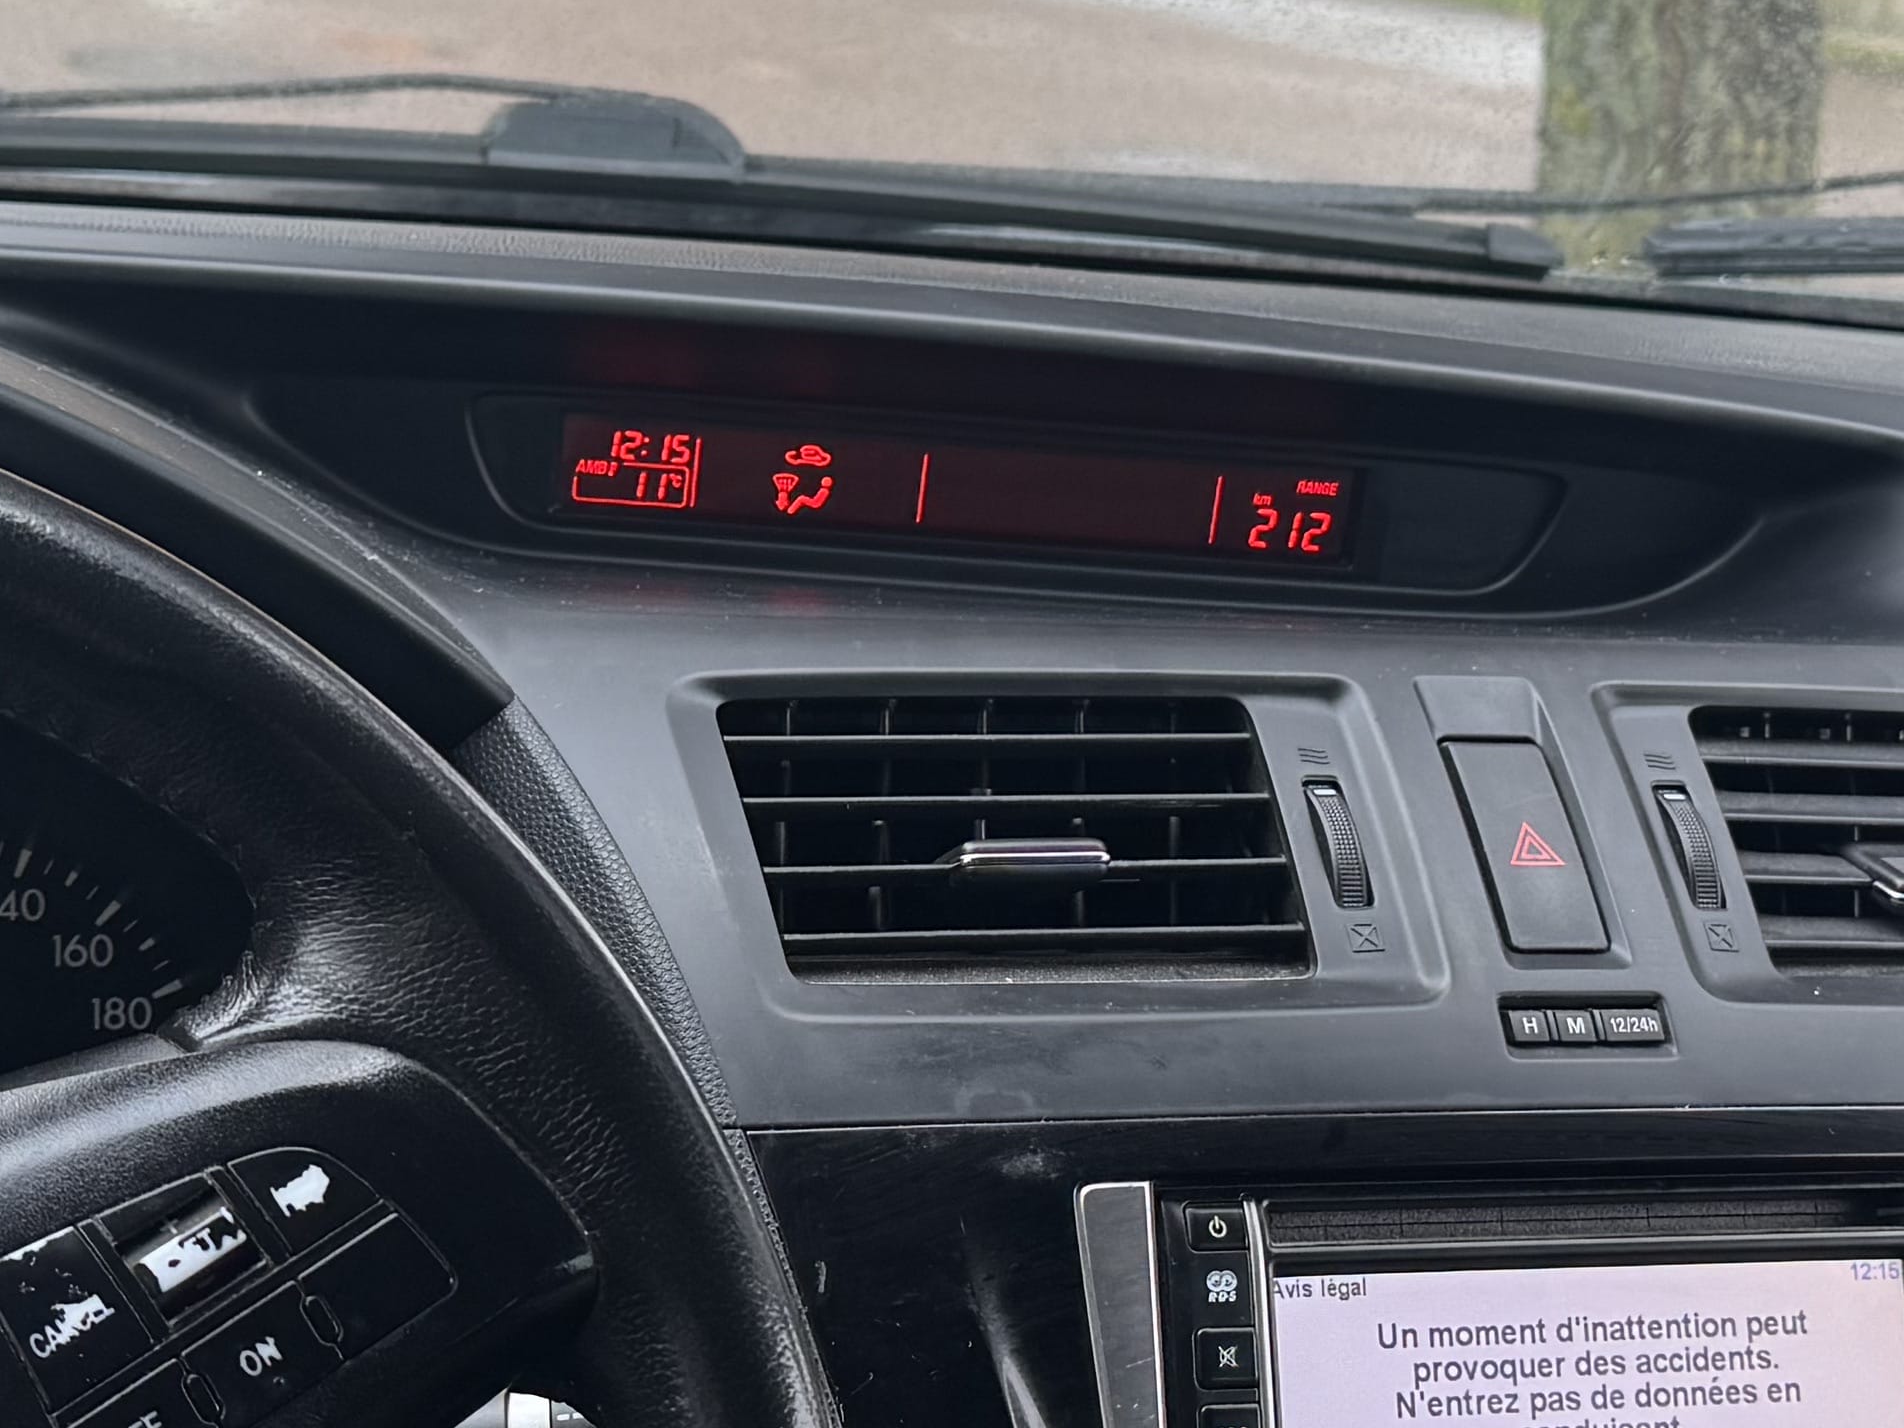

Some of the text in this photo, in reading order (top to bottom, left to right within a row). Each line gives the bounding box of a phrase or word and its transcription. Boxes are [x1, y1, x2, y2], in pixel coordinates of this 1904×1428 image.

[610, 430, 691, 463] 12:15
[1253, 492, 1273, 506] km
[1296, 479, 1339, 497] RANGE
[1247, 508, 1332, 552] 212
[53, 934, 114, 968] 160
[91, 997, 153, 1032] 180
[1523, 1017, 1538, 1035] H
[1567, 1017, 1586, 1035] M
[1610, 1017, 1658, 1034] 12/24h
[1850, 1261, 1900, 1281] 12:15
[1272, 1277, 1368, 1301] Avis légal
[1377, 1310, 1808, 1349] Un moment d'inattention peut
[239, 1335, 283, 1377] ON
[1413, 1345, 1780, 1390] provoquer des accidents.
[1396, 1377, 1802, 1420] N'entrez pas de données en
